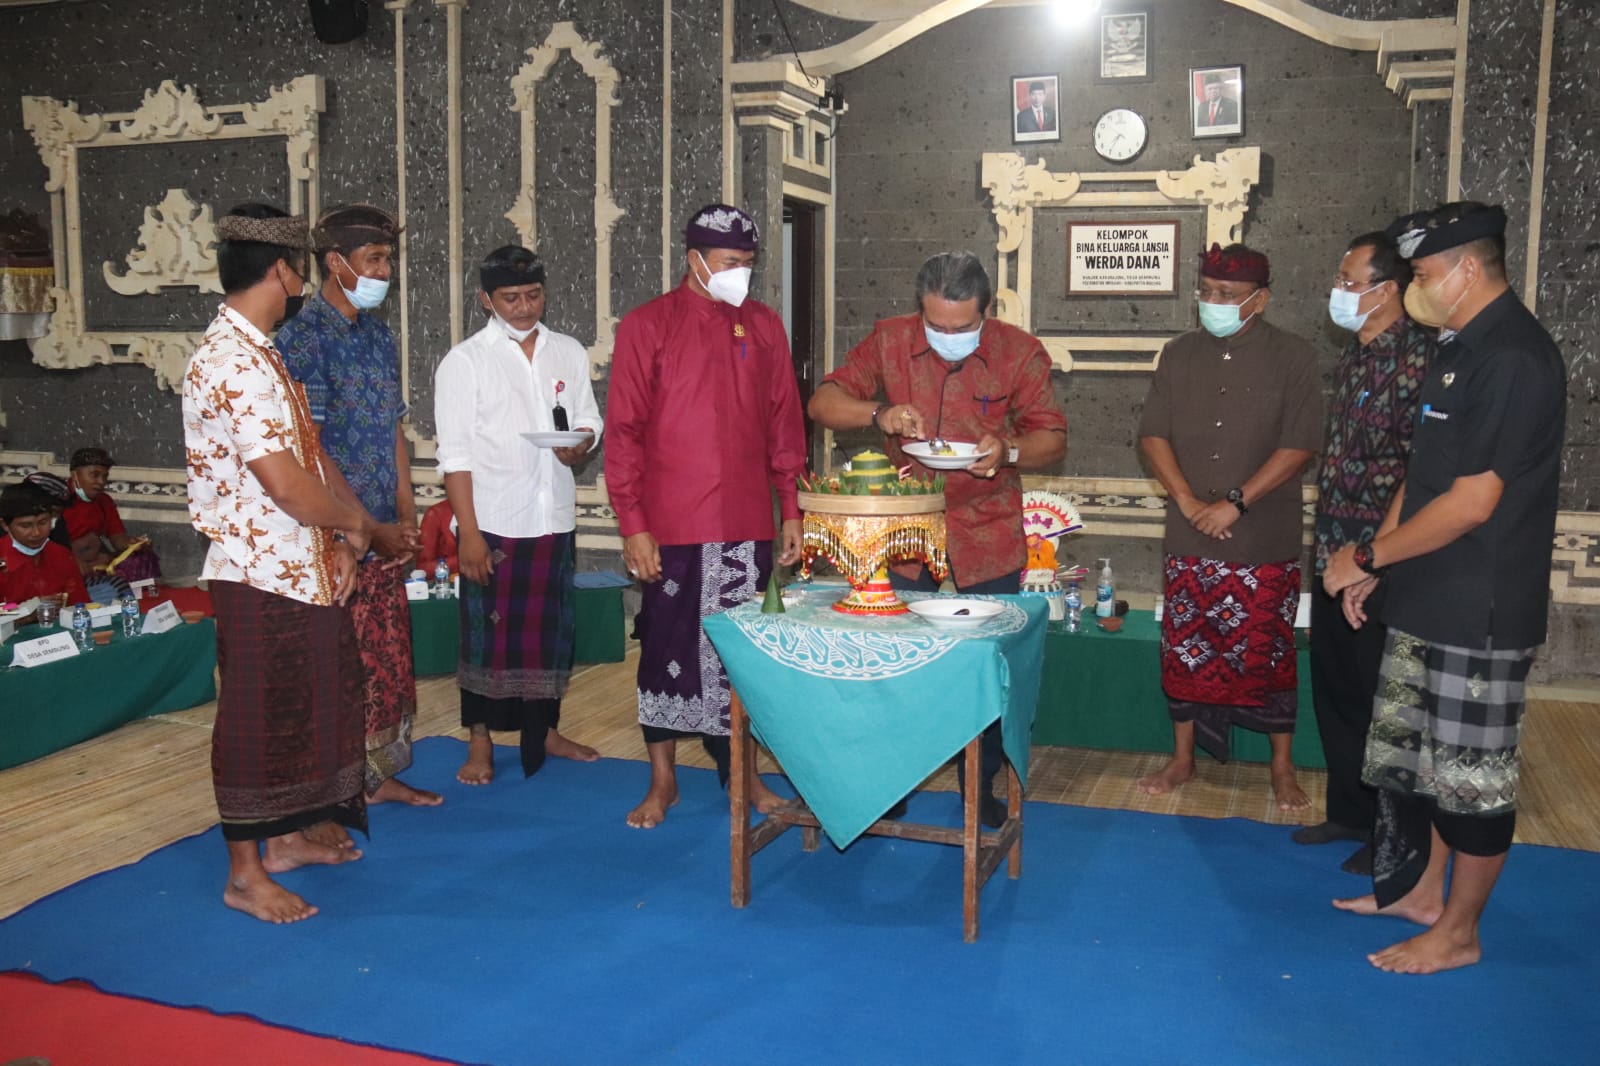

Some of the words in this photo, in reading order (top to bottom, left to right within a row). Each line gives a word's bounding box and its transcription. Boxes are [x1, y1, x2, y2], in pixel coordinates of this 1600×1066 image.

[1096, 229, 1148, 240] KELOMPOK
[1076, 242, 1095, 253] BINA
[1096, 242, 1140, 253] KELUARGA
[1142, 242, 1169, 253] LANSIA
